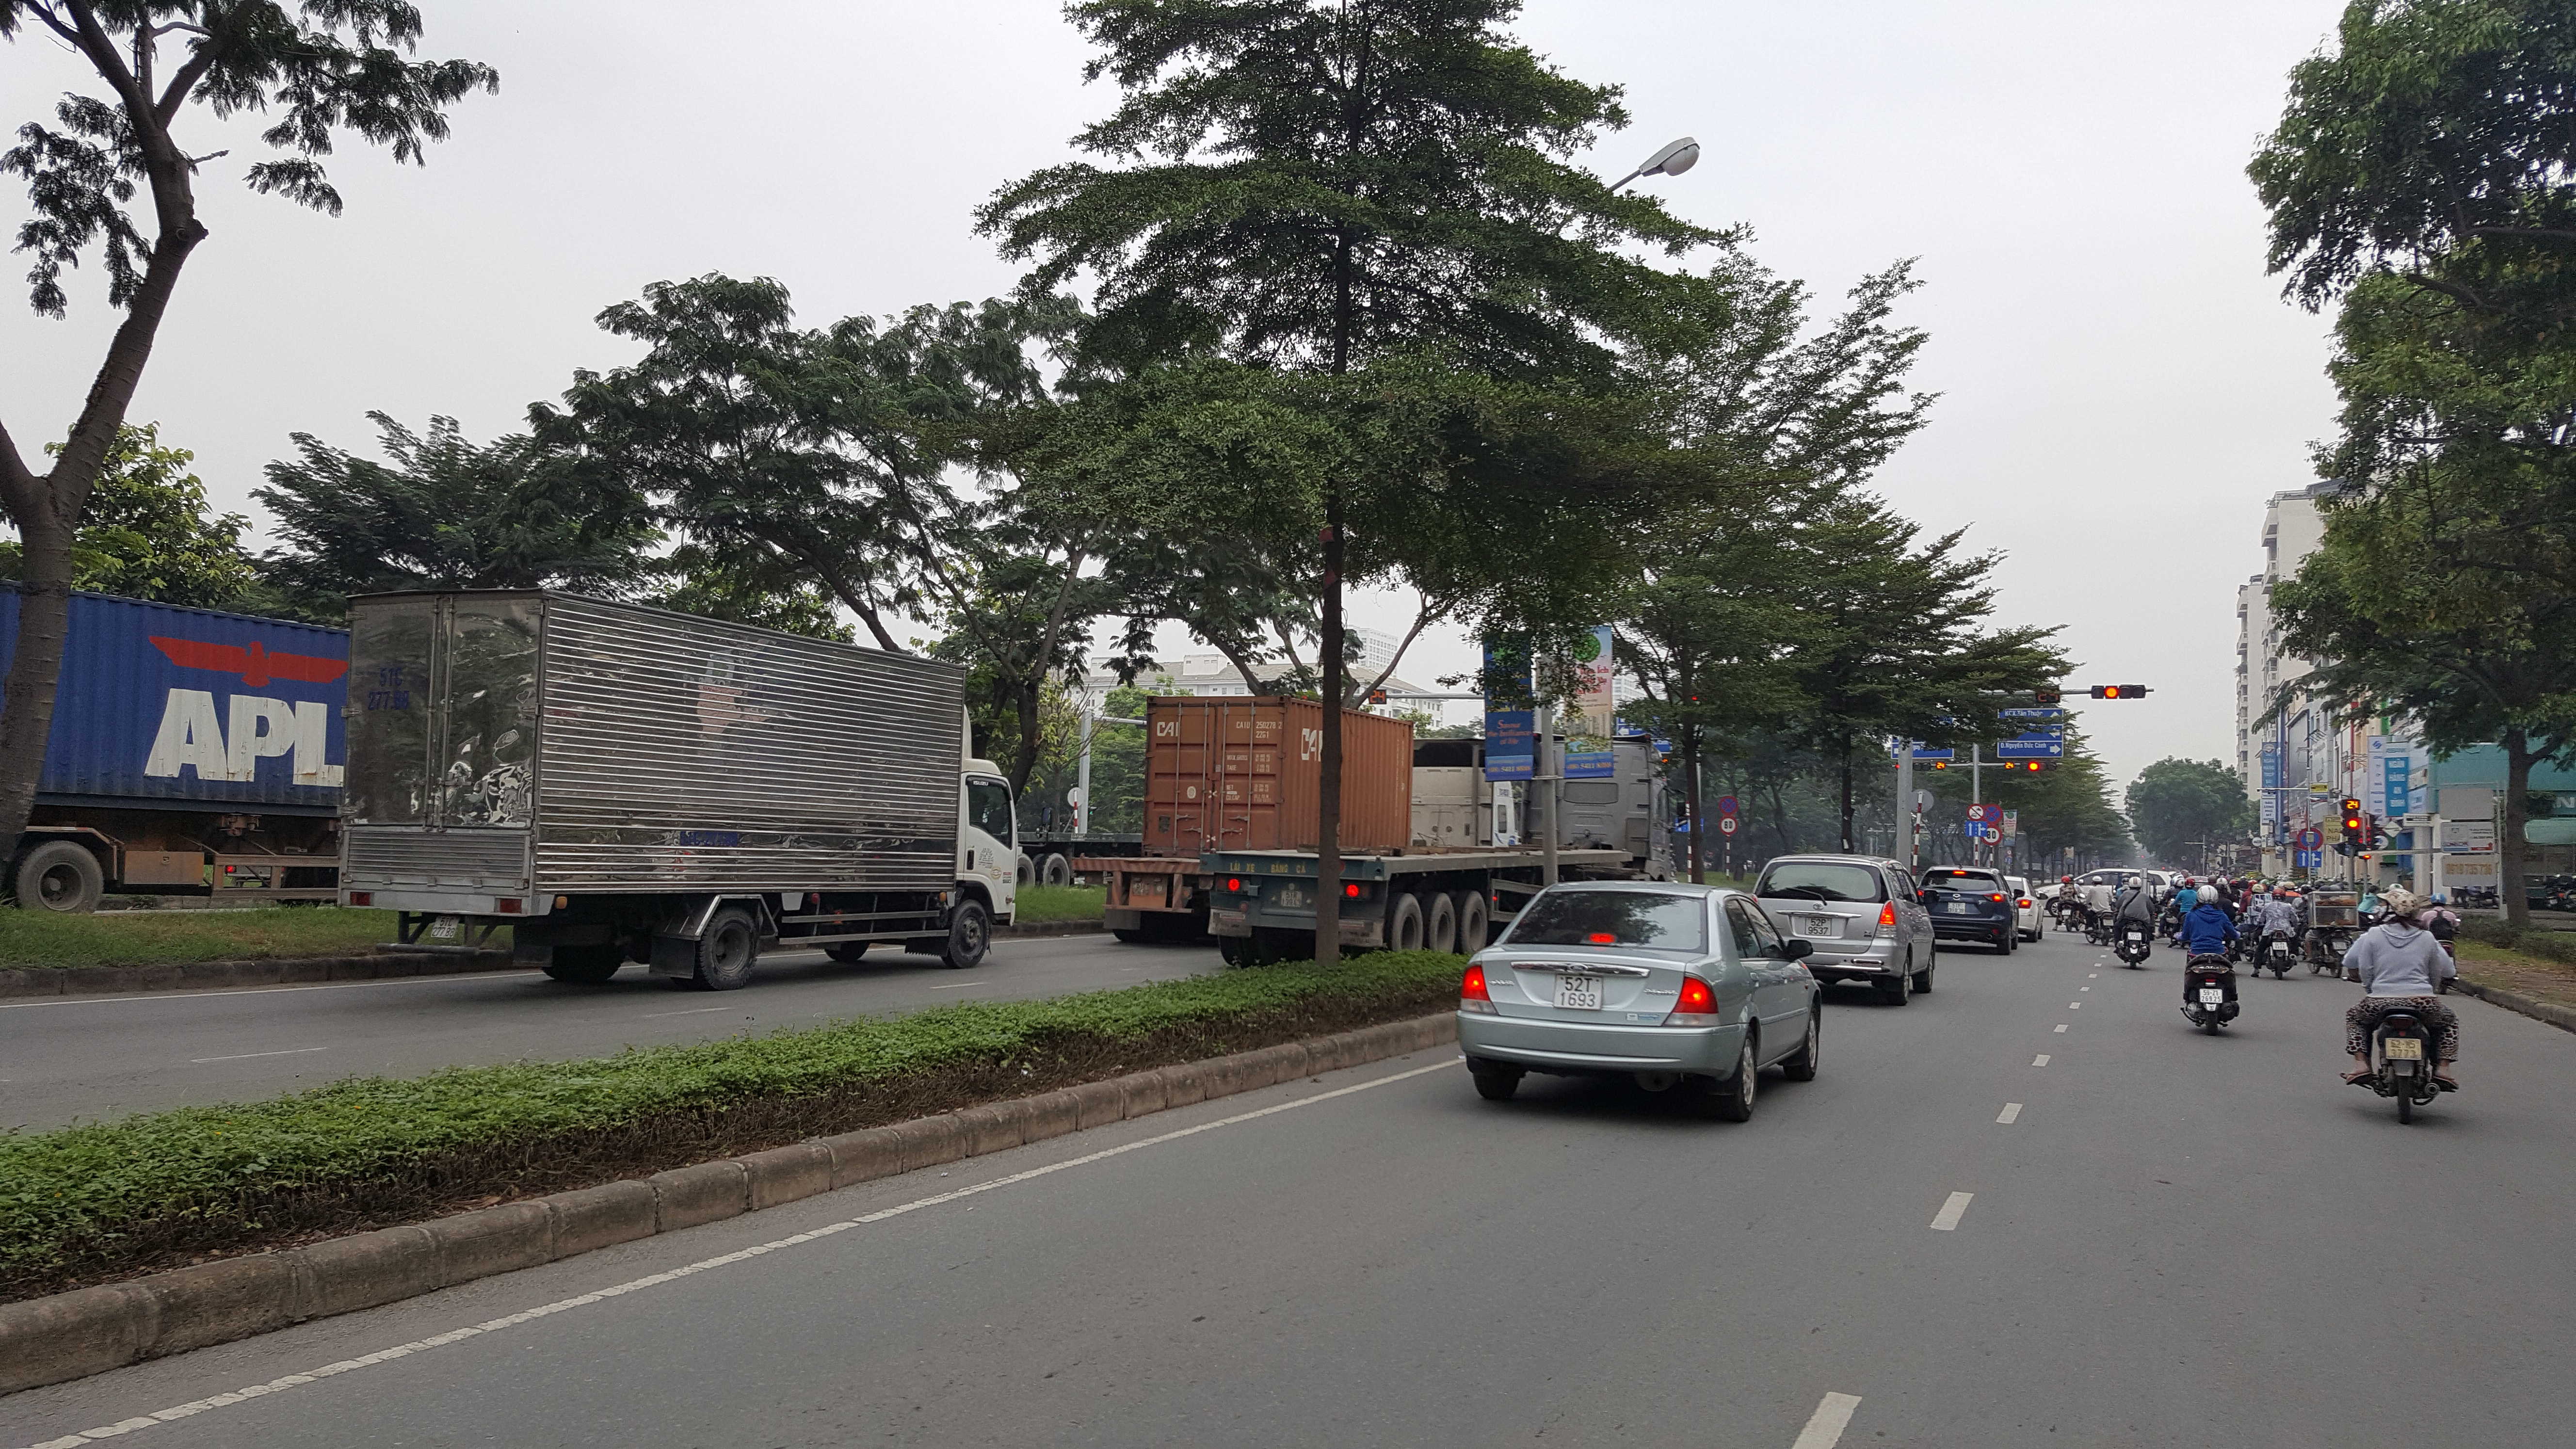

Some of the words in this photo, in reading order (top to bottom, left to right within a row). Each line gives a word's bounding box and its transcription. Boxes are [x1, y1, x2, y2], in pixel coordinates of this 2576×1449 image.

[144, 688, 344, 787] APL
[2346, 801, 2359, 809] 24
[1987, 830, 1996, 839] 80
[1246, 863, 1255, 872] XE
[440, 917, 454, 926] 51C
[1564, 978, 1591, 992] 52T
[1561, 992, 1595, 1007] 1693
